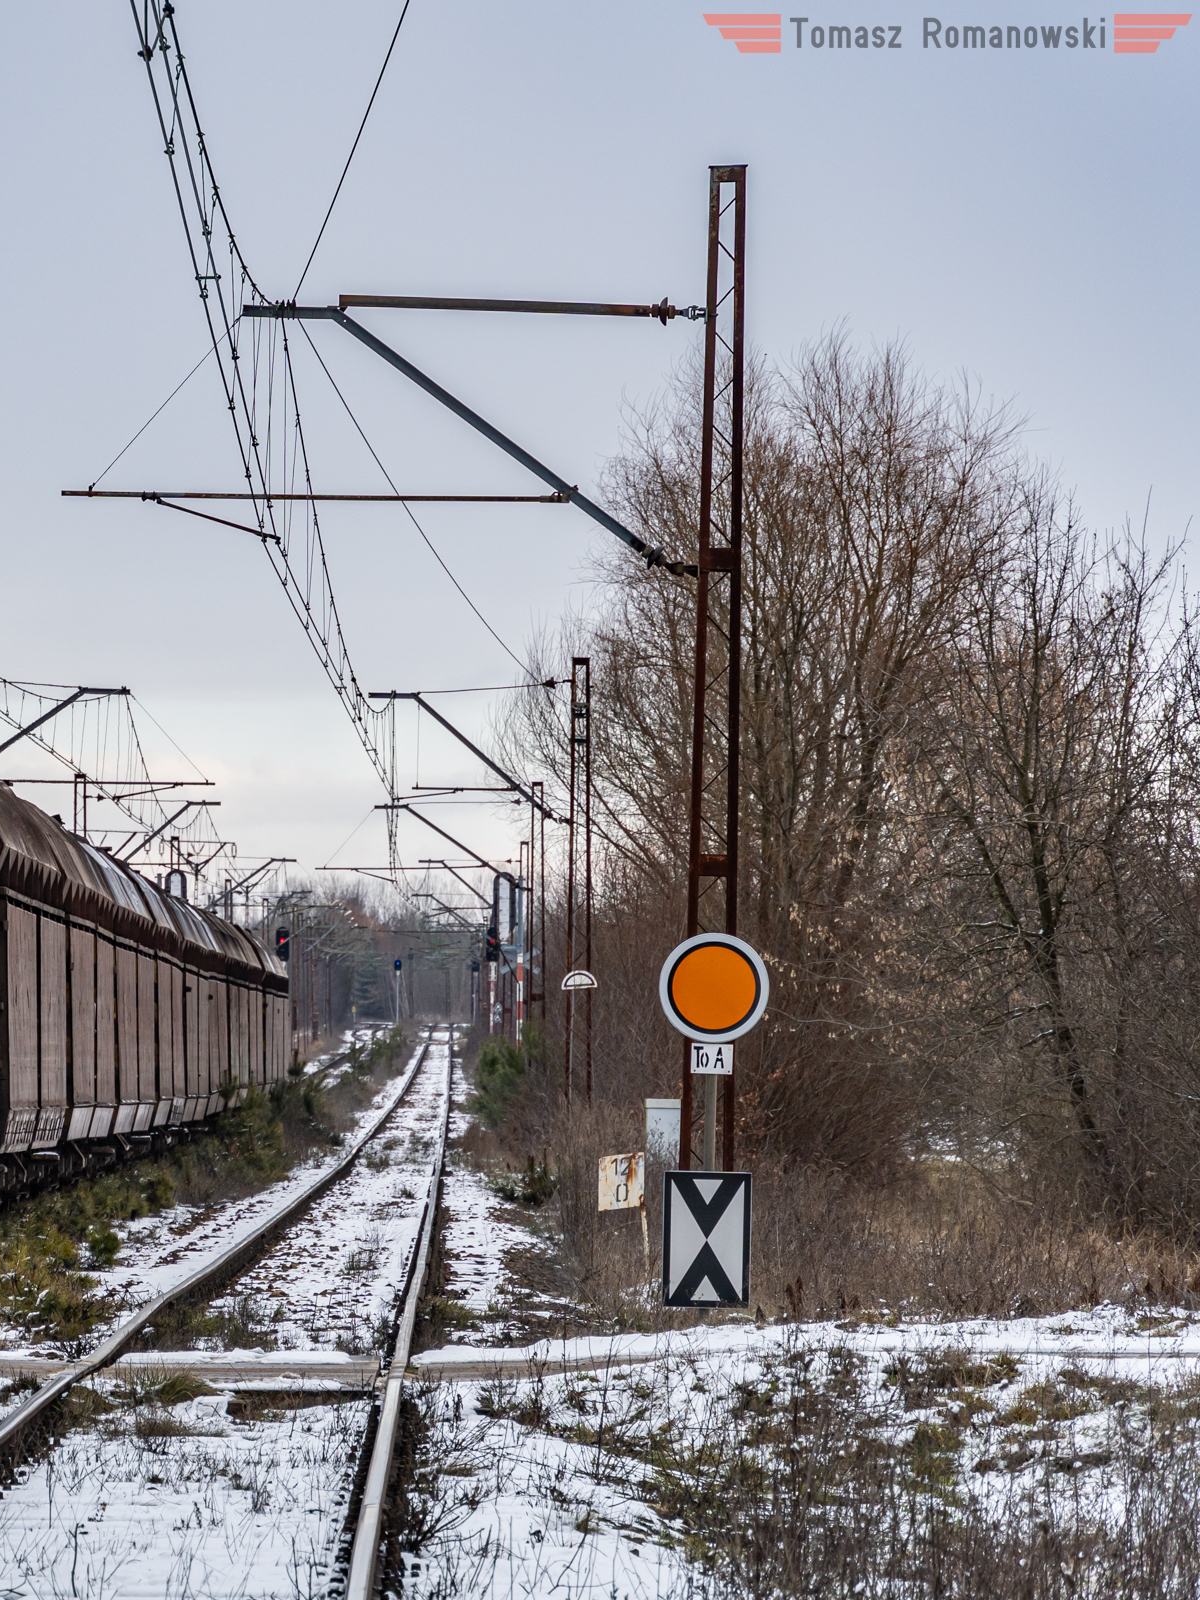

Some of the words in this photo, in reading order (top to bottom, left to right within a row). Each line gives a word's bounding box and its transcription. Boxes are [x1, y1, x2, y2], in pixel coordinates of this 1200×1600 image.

[693, 1046, 709, 1068] To
[713, 1046, 724, 1069] A
[611, 1157, 632, 1176] 12
[616, 1183, 628, 1202] 0
